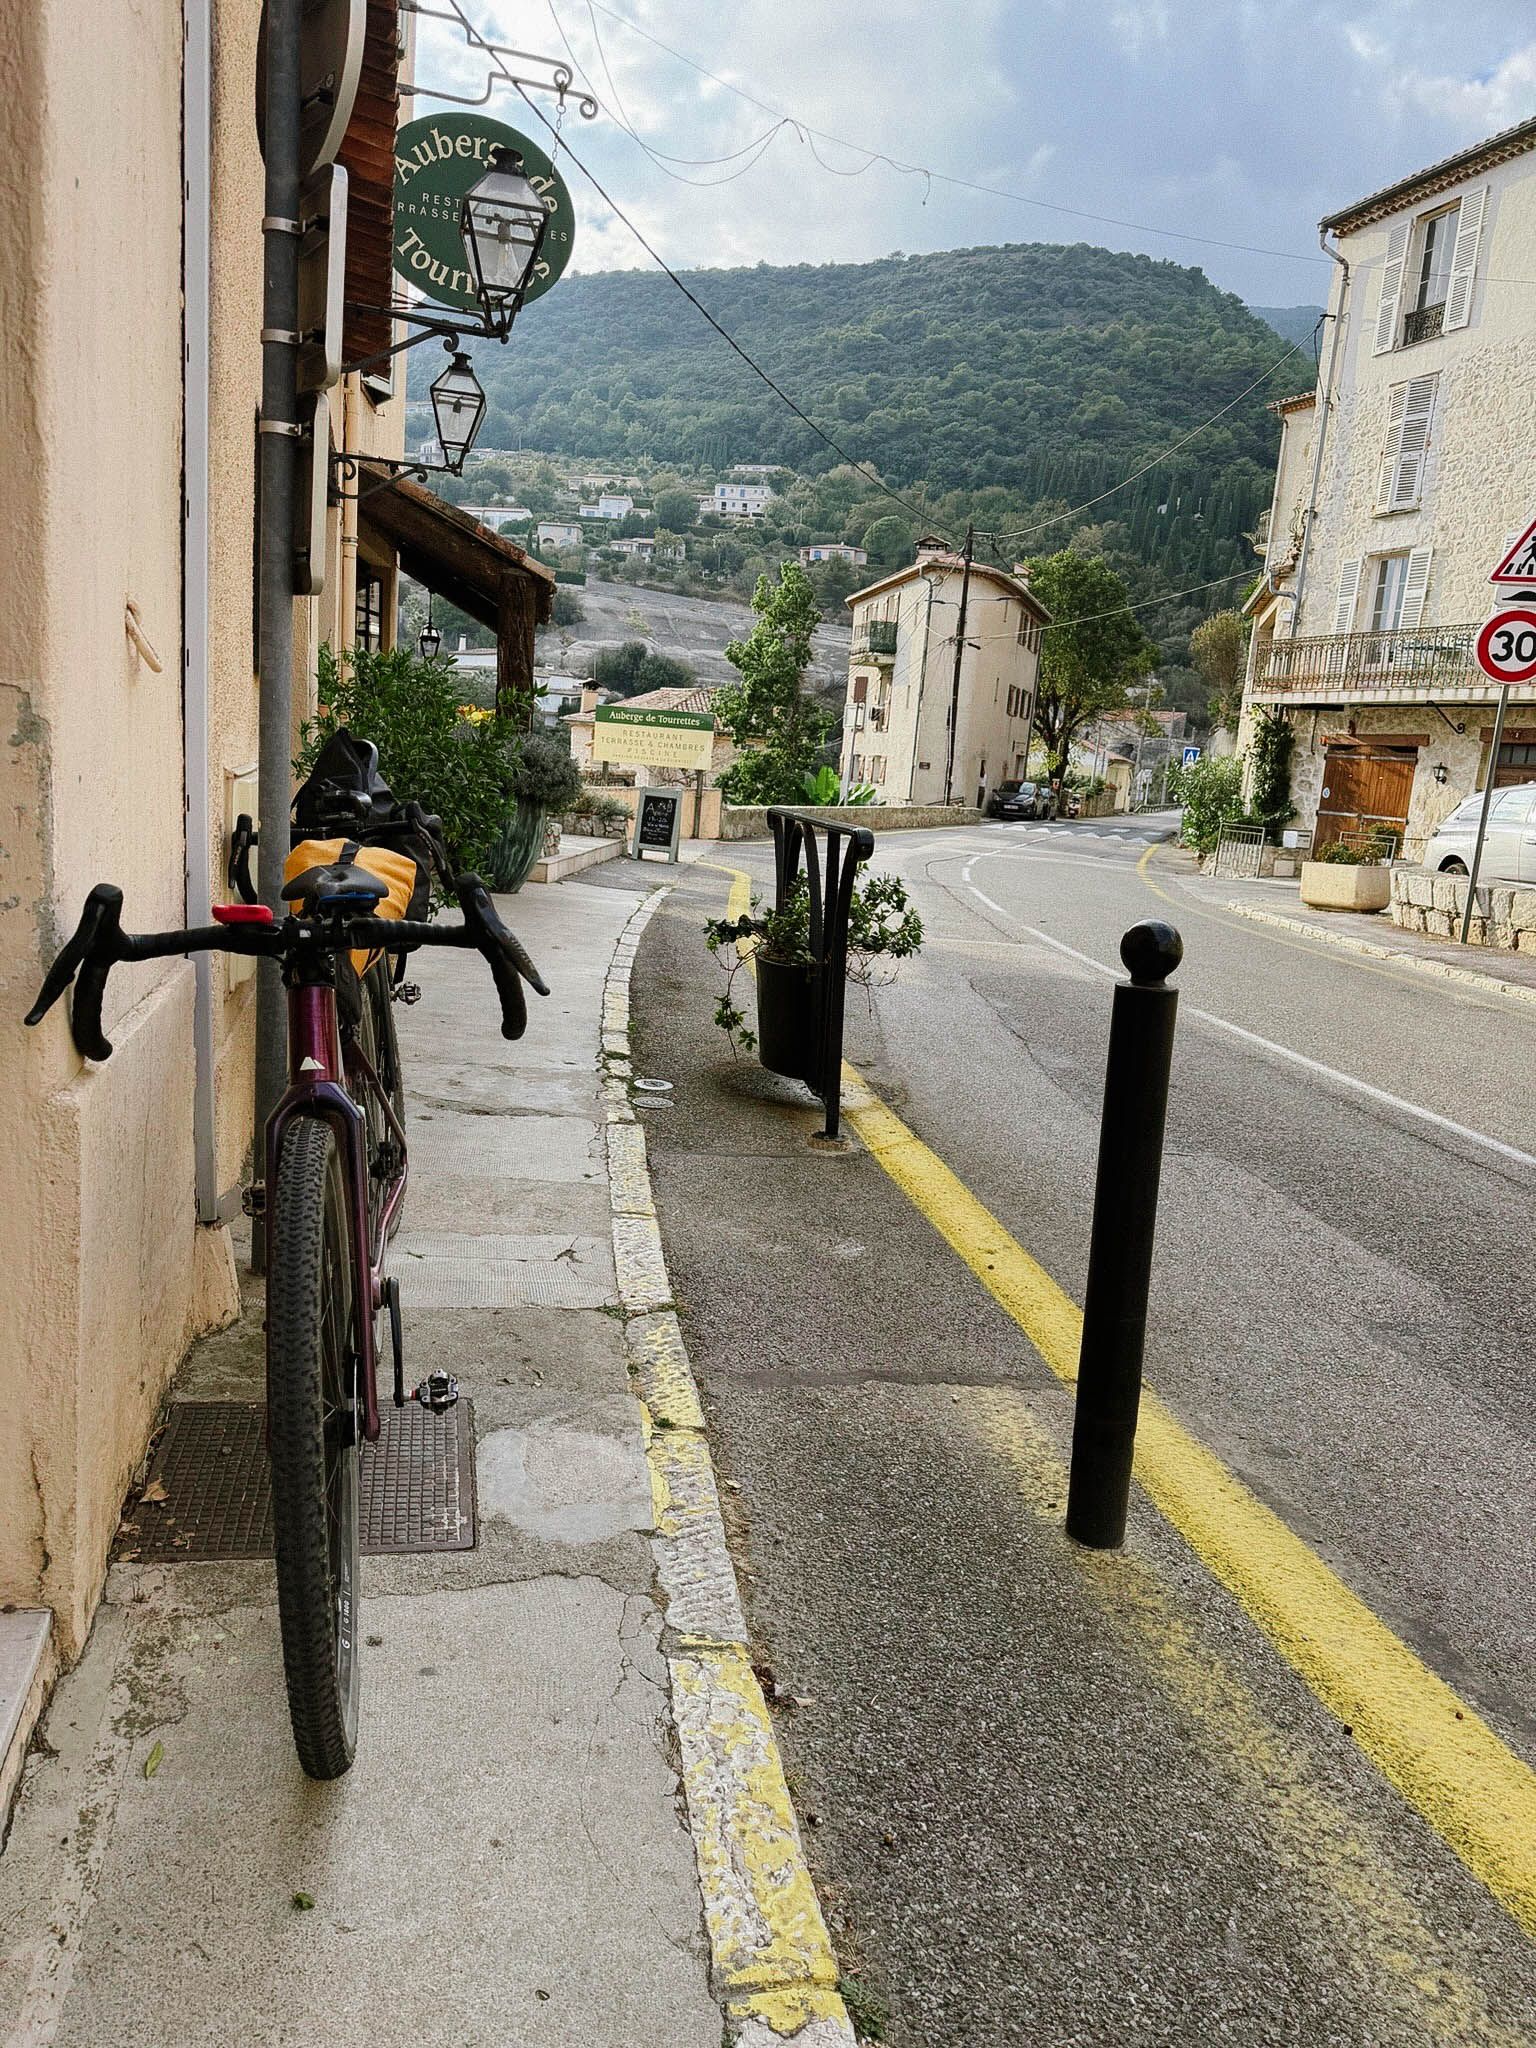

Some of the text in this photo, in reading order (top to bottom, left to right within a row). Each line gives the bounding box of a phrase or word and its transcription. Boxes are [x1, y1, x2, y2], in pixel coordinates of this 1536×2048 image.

[395, 128, 559, 214] Auber de
[397, 201, 460, 223] RRASSE
[1491, 630, 1536, 662] 30
[609, 710, 700, 726] Auberge de Tourrettes
[622, 729, 684, 741] RESTAURANT
[601, 736, 645, 747] TERRASSE
[657, 742, 705, 752] CHAMBRES
[627, 747, 678, 758] PISCINE
